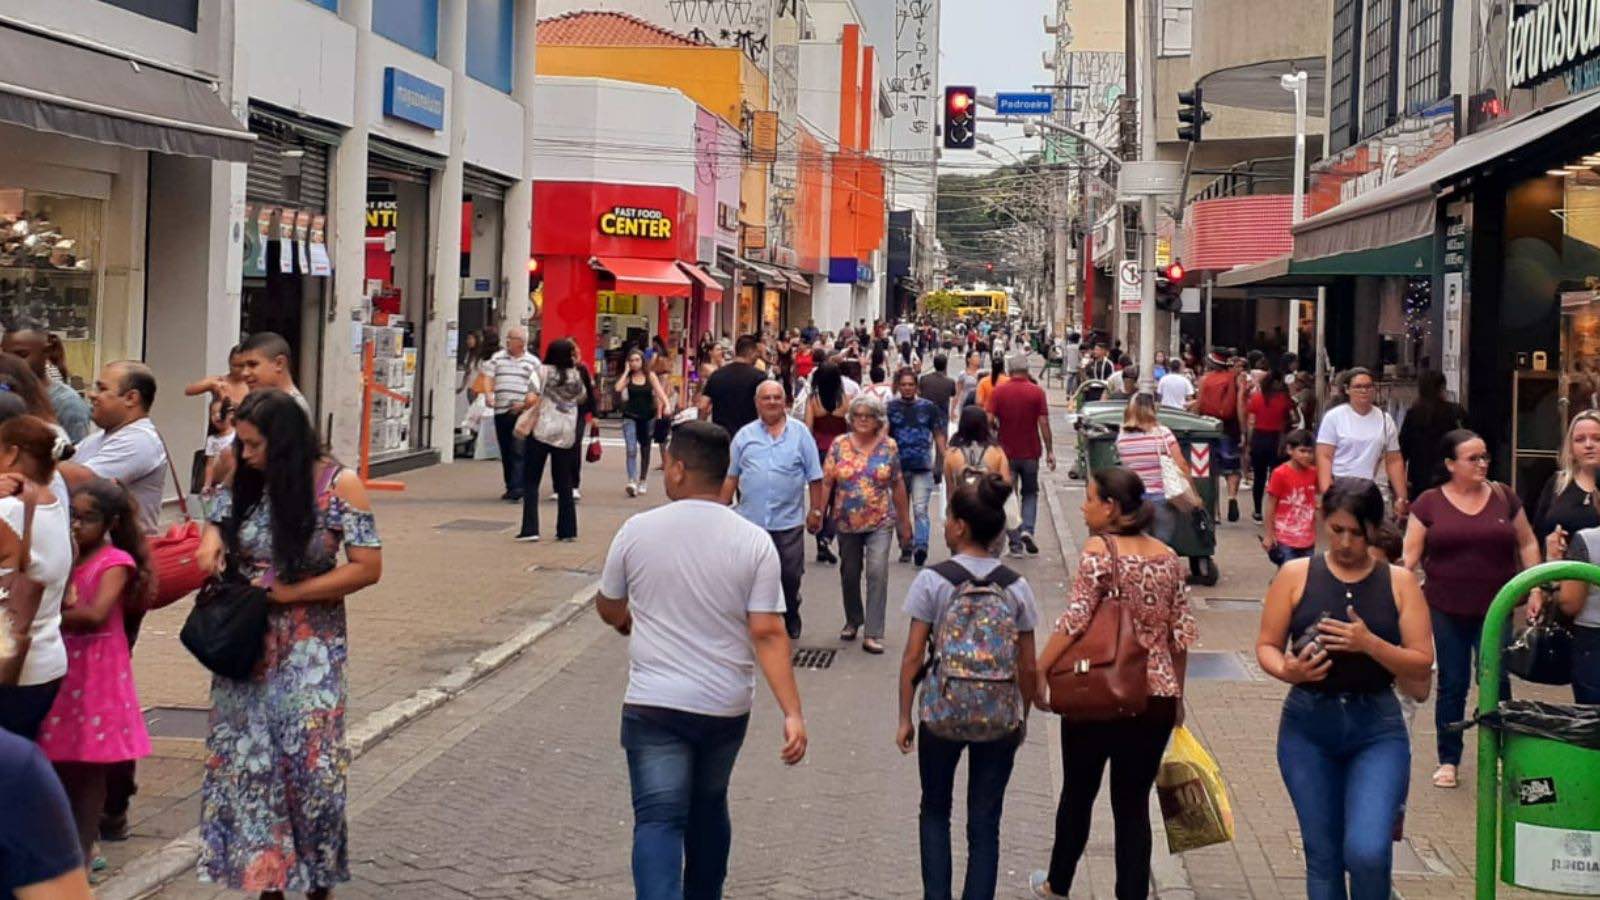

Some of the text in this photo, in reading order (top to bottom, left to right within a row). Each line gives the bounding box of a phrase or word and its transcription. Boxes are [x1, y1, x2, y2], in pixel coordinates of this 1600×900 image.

[614, 207, 663, 220] FAST FOOD
[601, 213, 671, 238] CENTER
